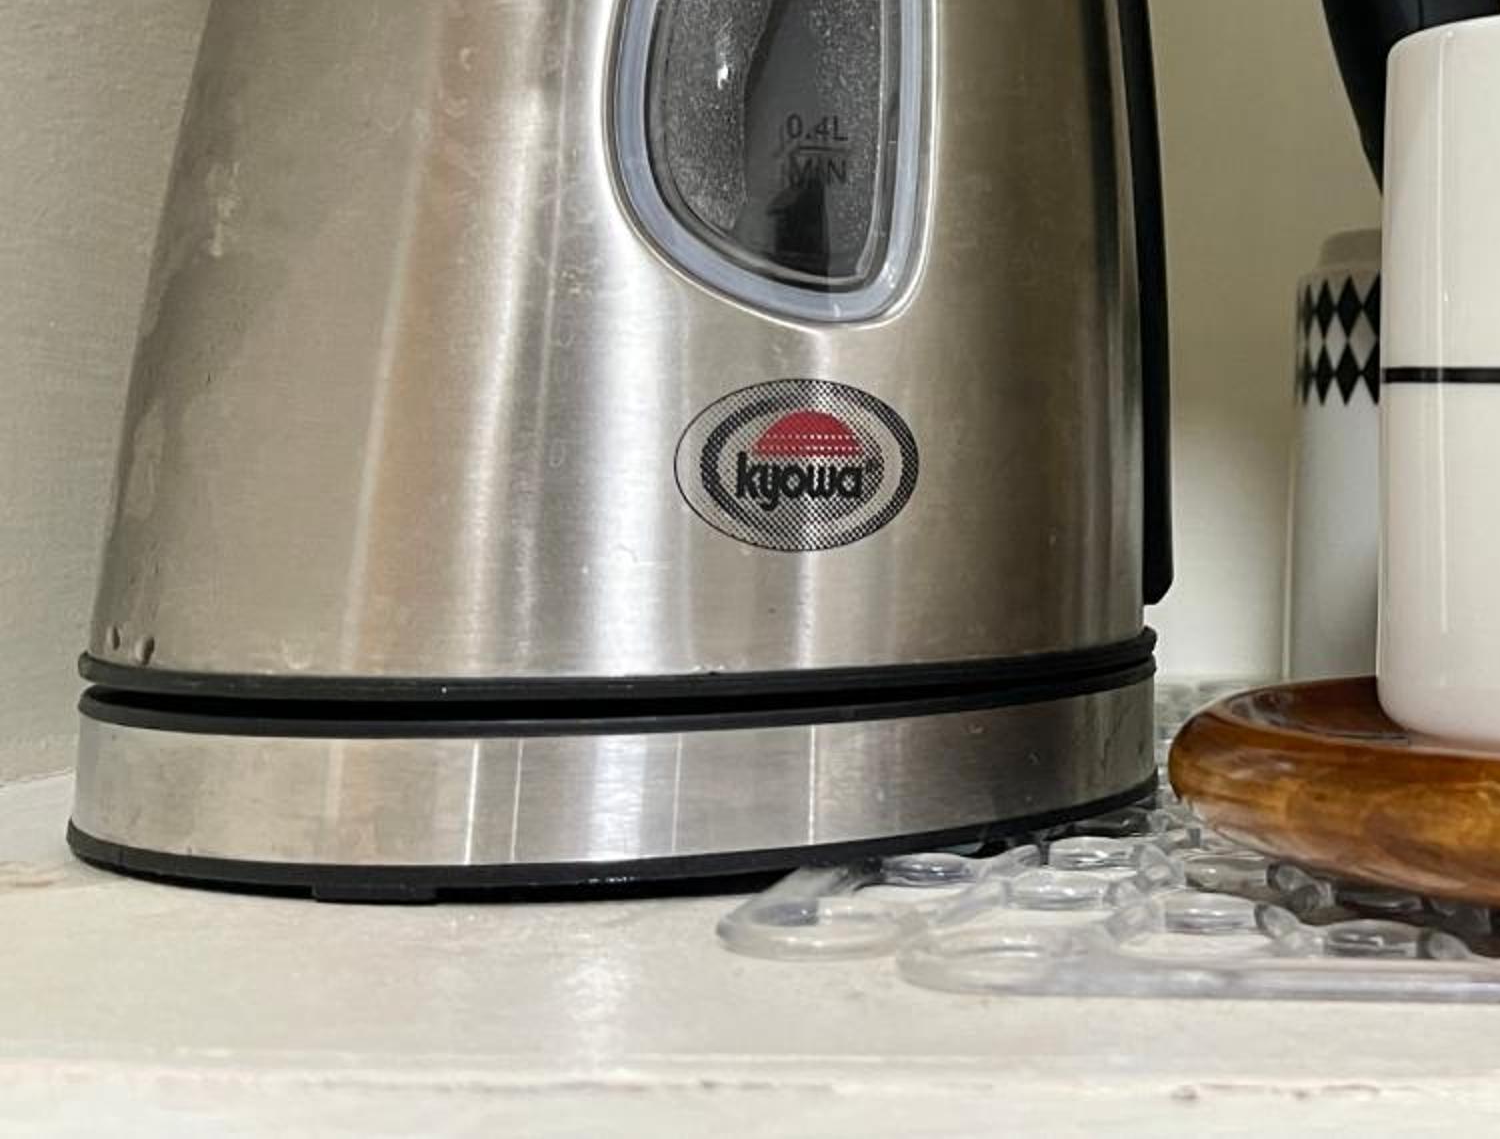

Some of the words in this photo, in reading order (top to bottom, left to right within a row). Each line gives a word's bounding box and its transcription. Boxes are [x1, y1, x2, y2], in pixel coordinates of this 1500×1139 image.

[787, 113, 848, 141] 0.4L
[787, 154, 847, 186] MIN
[735, 451, 863, 511] kyowa
